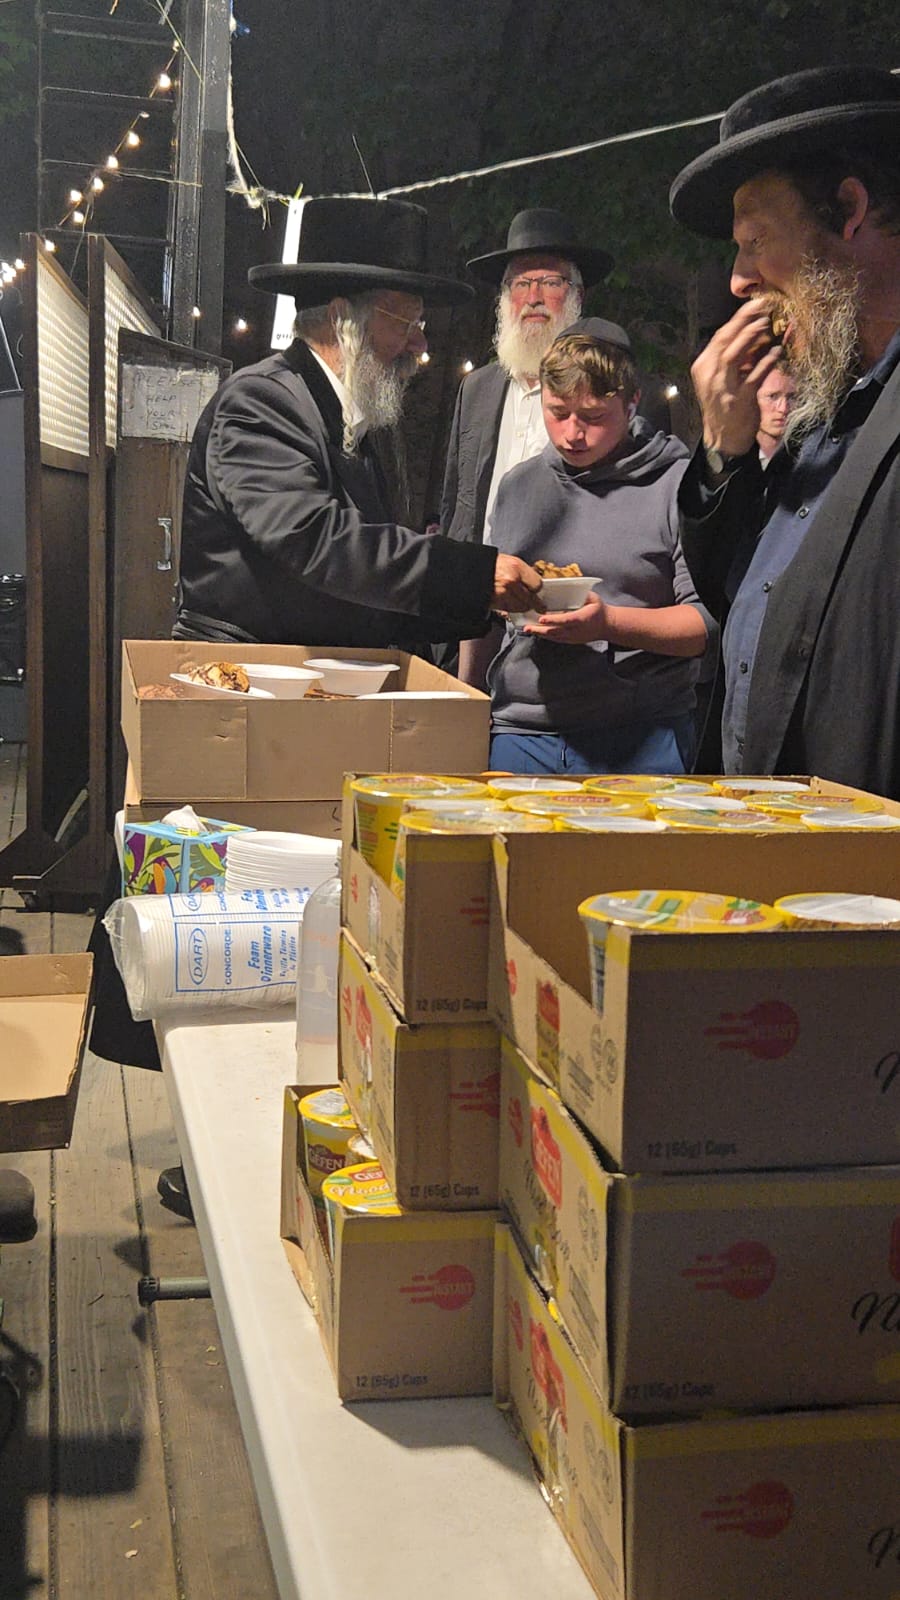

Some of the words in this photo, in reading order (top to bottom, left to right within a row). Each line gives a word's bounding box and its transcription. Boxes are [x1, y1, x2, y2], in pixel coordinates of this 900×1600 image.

[146, 394, 177, 406] HELP
[193, 935, 203, 978] DART
[224, 929, 232, 985] CONCORDE
[248, 940, 260, 969] Foam
[261, 925, 273, 982] Dinnerware
[309, 1153, 344, 1170] GEFEN
[453, 1183, 480, 1198] Cups
[356, 1375, 368, 1387] 12
